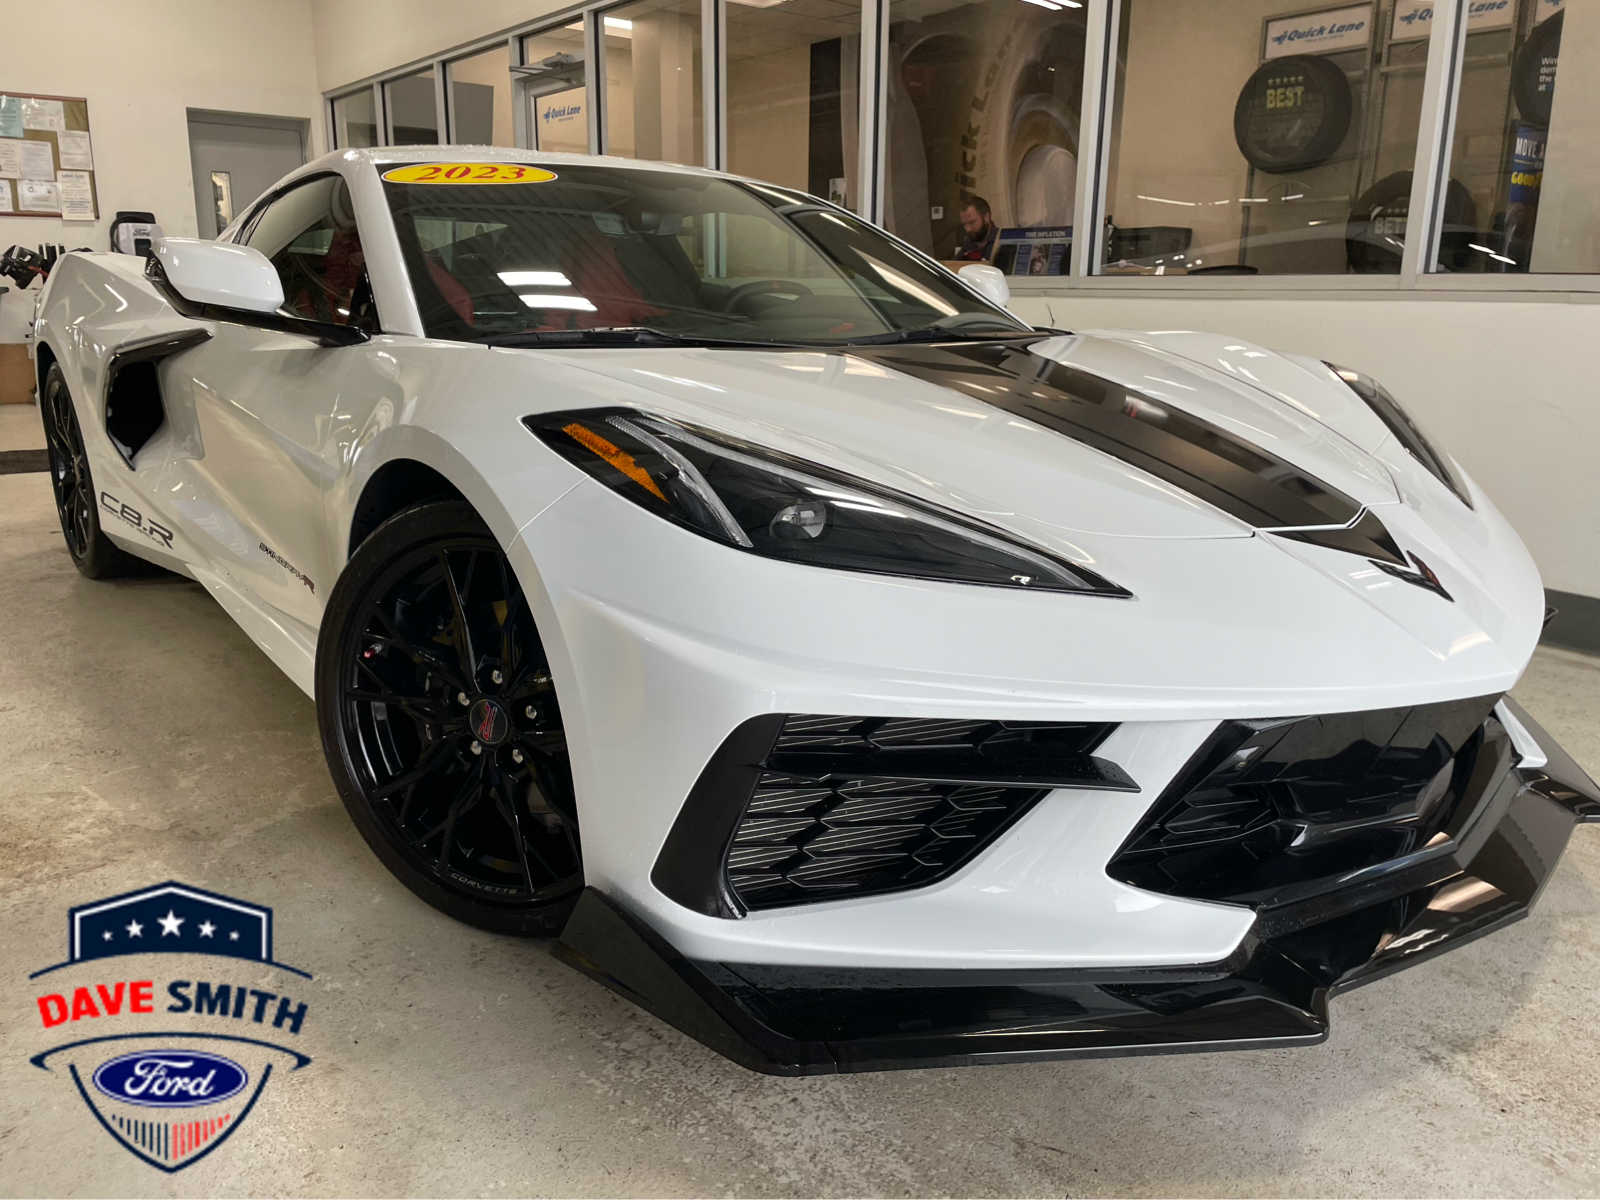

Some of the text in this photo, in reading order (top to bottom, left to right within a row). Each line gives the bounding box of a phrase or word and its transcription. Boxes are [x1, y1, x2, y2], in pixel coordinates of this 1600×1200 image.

[1287, 26, 1326, 40] Quick
[1328, 21, 1365, 34] Lane
[1266, 86, 1304, 109] BEST
[1515, 137, 1537, 158] MOVE
[415, 166, 527, 181] 2023
[451, 872, 518, 896] CORVETTE
